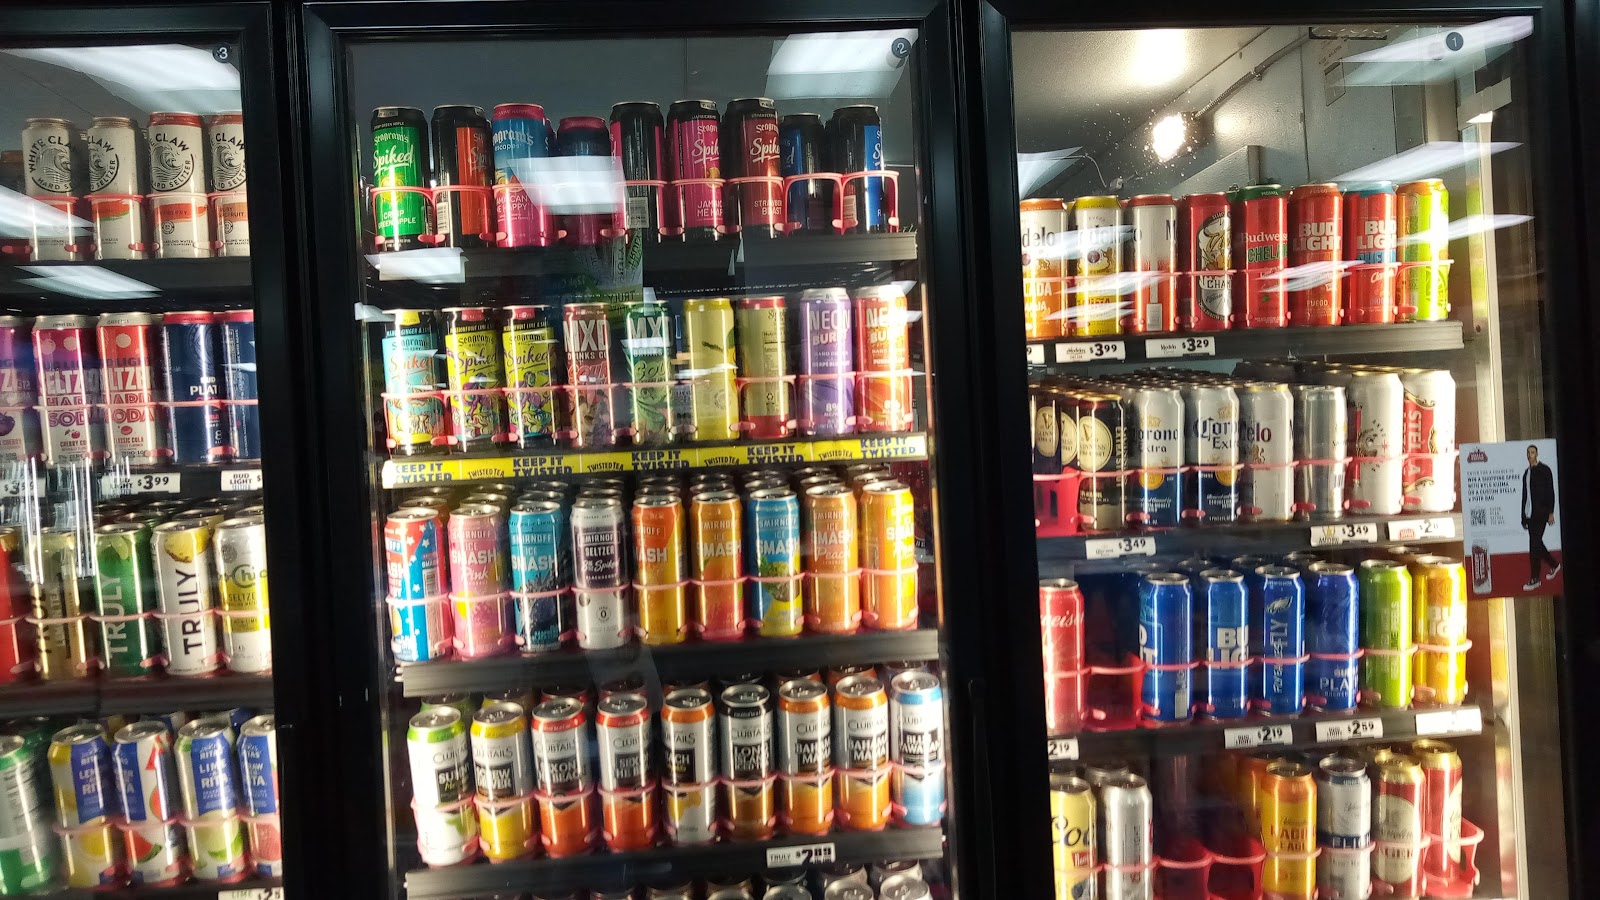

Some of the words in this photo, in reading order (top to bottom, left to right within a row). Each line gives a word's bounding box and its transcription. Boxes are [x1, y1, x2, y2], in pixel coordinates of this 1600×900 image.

[219, 46, 229, 60] 3
[895, 42, 907, 55] 2
[373, 144, 414, 172] Spiked
[383, 209, 405, 220] CRP
[761, 206, 782, 216] BAST
[1299, 220, 1336, 236] BUD
[861, 437, 892, 449] KEEP
[631, 450, 662, 463] KEEP
[665, 450, 681, 461] IT
[747, 445, 779, 457] KEEP
[781, 444, 796, 456] IT
[861, 446, 916, 458] TWISTED
[431, 462, 443, 472] IT
[513, 457, 547, 469] KEEP
[549, 456, 564, 467] IT
[514, 465, 572, 477] TWISTED
[585, 546, 616, 557] SELTZER
[103, 575, 129, 659] TRULY
[176, 567, 203, 656] TRULY
